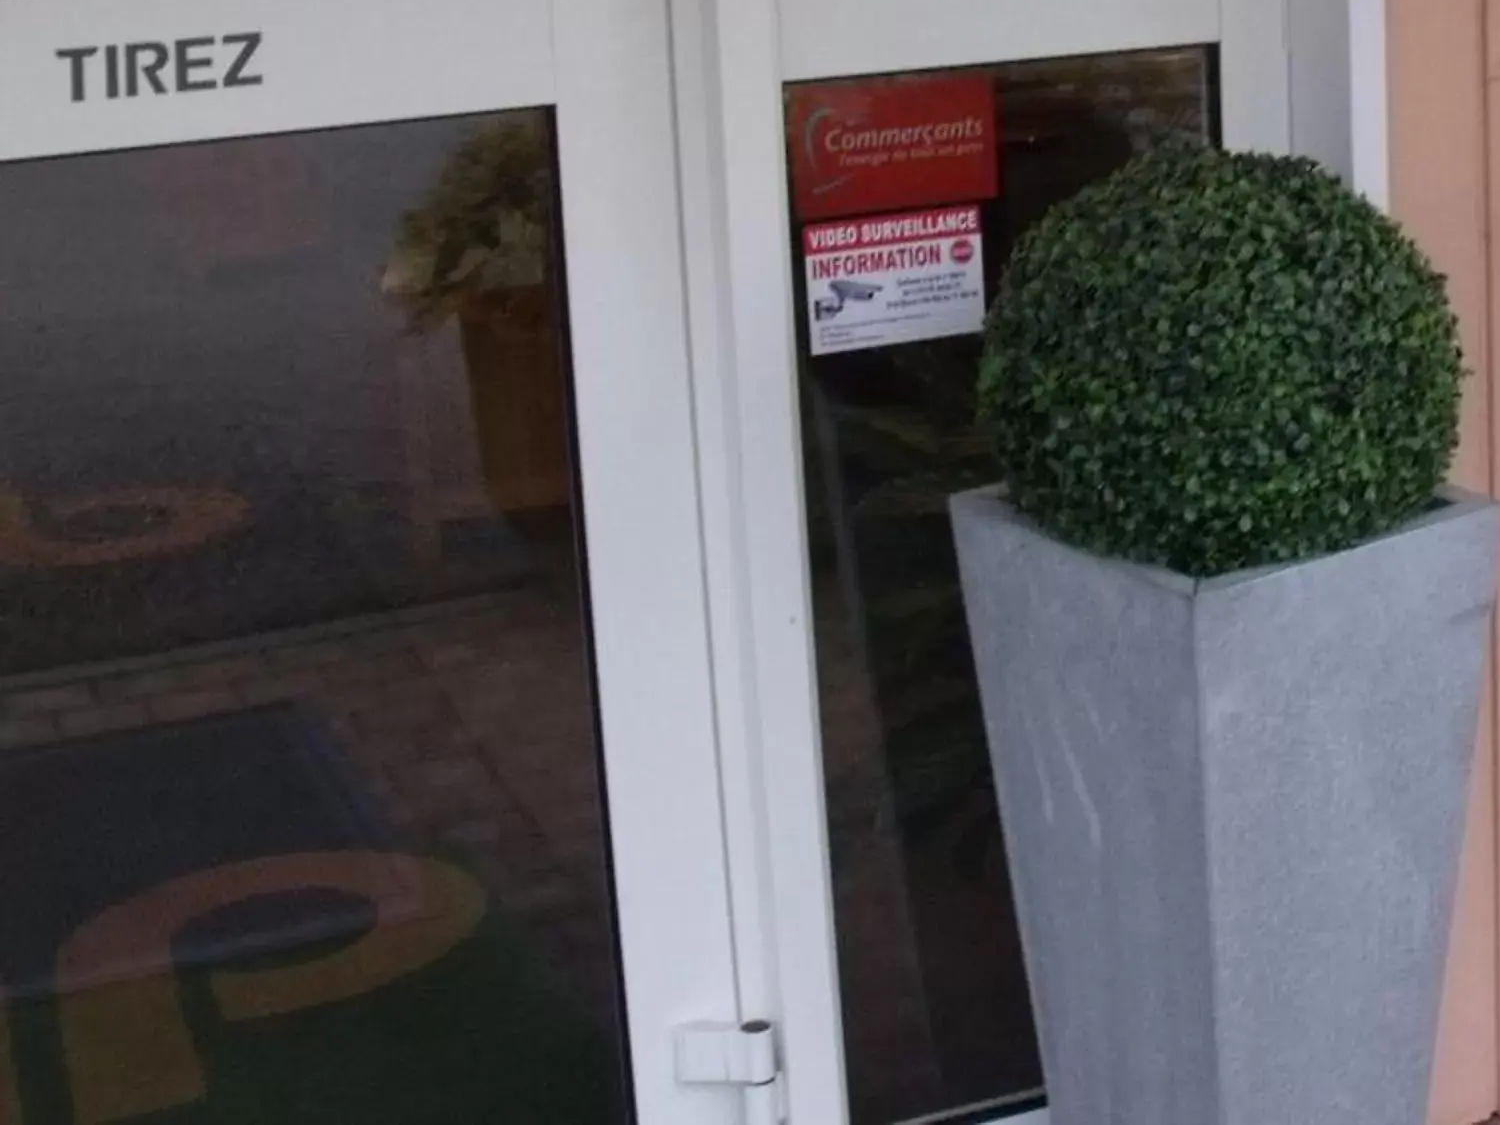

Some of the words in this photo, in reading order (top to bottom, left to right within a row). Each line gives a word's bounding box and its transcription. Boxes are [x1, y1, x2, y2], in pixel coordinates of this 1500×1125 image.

[54, 31, 265, 104] TIREZ
[824, 115, 984, 155] Commerçants
[807, 226, 858, 251] VIDEO
[860, 209, 979, 245] SURVEILLANCE
[811, 242, 942, 281] INFORMATION
